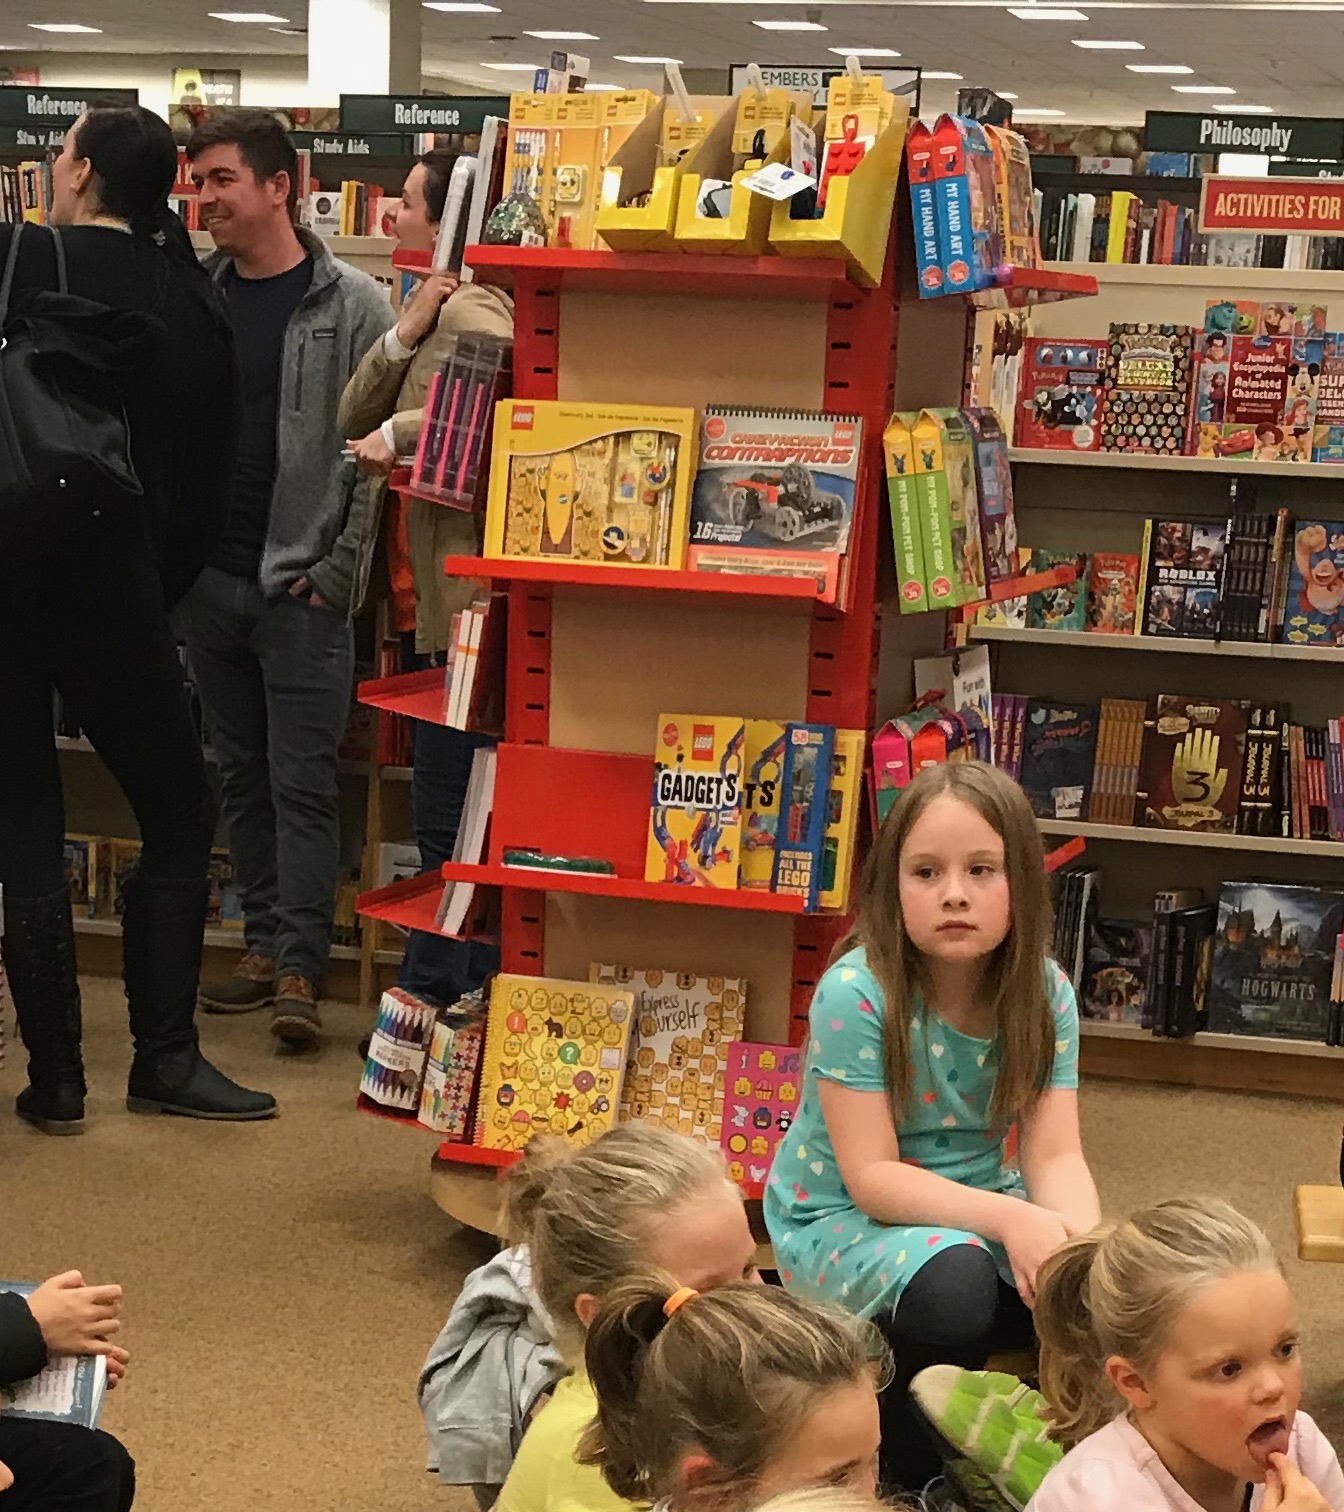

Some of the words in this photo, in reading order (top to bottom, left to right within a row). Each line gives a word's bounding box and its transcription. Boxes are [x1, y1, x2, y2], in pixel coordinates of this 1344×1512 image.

[749, 71, 819, 87] EMBERS
[27, 94, 88, 116] Reference
[394, 103, 460, 126] Reference
[16, 129, 46, 146] Stuy
[49, 130, 64, 146] Aid
[1199, 118, 1293, 153] Philosophy
[313, 138, 344, 154] Study
[347, 138, 370, 155] Aids
[920, 188, 932, 203] MY
[946, 182, 958, 198] MY
[1214, 192, 1305, 219] ACTIVITIES
[1308, 195, 1341, 220] FOR
[921, 207, 935, 237] HAND
[947, 201, 961, 232] HAND
[924, 240, 937, 261] ART
[950, 235, 963, 255] ART
[1246, 352, 1276, 364] Junior
[1232, 361, 1286, 375] Encyclopedia
[1234, 378, 1282, 390] Animated
[1232, 387, 1282, 400] Characters
[513, 412, 534, 423] LEGO
[705, 445, 853, 464] CONTRAPTIONS
[693, 522, 714, 540] 16
[1158, 568, 1217, 581] ROBLOX
[962, 681, 974, 694] Fun
[694, 736, 713, 750] LEGO
[792, 730, 808, 744] 58
[1246, 741, 1258, 783] JOURNAL
[1259, 741, 1272, 783] JOURNAL
[660, 772, 738, 806] GADGETS
[1182, 770, 1211, 801] 3
[1244, 783, 1255, 796] 3
[1258, 784, 1270, 796] 3
[777, 869, 810, 886] LEGO
[1241, 978, 1316, 1001] HOGWARTS
[640, 990, 679, 1014] Express
